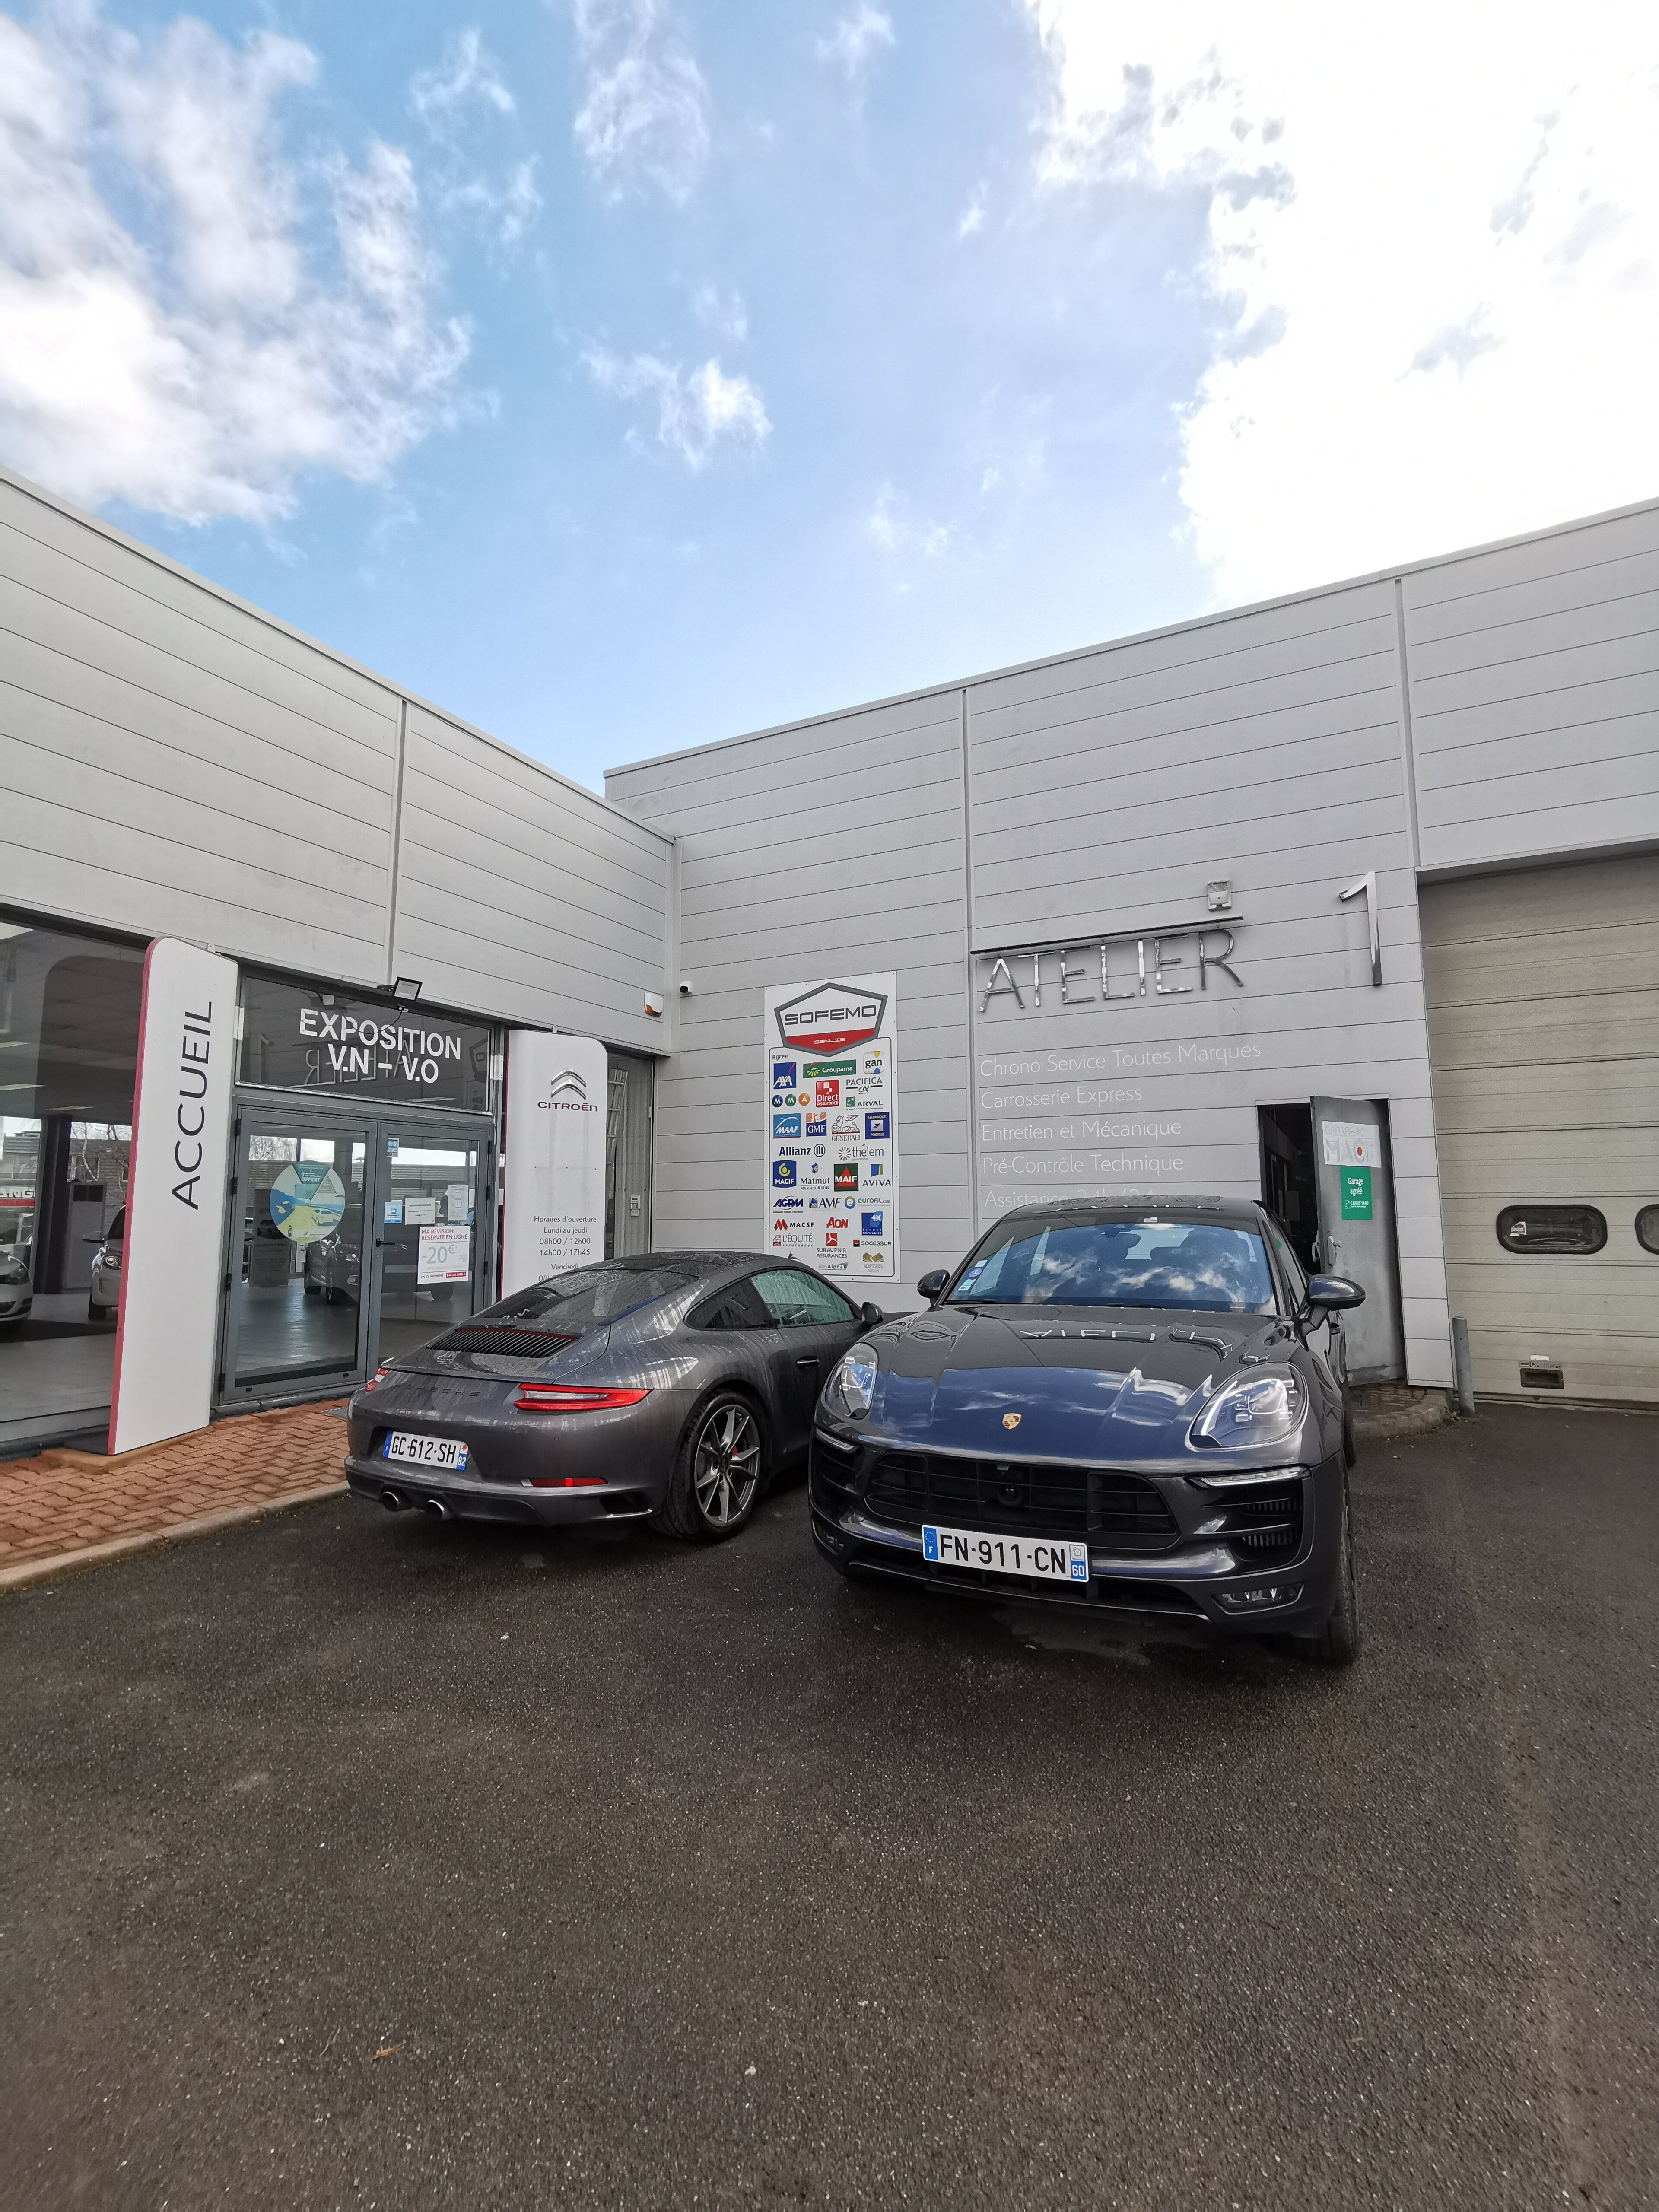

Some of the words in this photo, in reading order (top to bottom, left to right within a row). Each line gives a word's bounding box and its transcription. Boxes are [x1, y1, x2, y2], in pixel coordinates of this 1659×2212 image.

[979, 928, 1244, 1012] ATELIER
[1339, 871, 1383, 987] 1
[785, 1004, 877, 1026] SOFEMO
[299, 1008, 461, 1060] EXPOSITION
[327, 1043, 369, 1074] V.N
[402, 1055, 439, 1083] V.O
[865, 1059, 882, 1069] gan
[980, 1058, 1041, 1077] Chrono
[1047, 1055, 1106, 1072] Service
[1112, 1049, 1171, 1068] Toutes
[1178, 1044, 1262, 1065] Marques
[773, 1075, 793, 1087] AXA
[846, 1077, 883, 1086] PACIFICA
[817, 1093, 839, 1102] Direct
[981, 1089, 1070, 1109] Carrosserie
[1077, 1085, 1143, 1107] Express
[172, 1001, 212, 1210] ACCUEIL
[775, 1126, 799, 1134] MAAF
[807, 1125, 826, 1134] GMF
[983, 1124, 1053, 1141] Entretien
[1059, 1126, 1076, 1139] et
[1083, 1120, 1182, 1141] Mécanique
[779, 1146, 811, 1156] Allianz
[852, 1144, 884, 1157] thélem
[983, 1154, 1084, 1175] Pré-Contrôle
[1090, 1152, 1183, 1176] Technique
[1348, 1177, 1364, 1187] Garage
[773, 1198, 804, 1208] AGPM
[819, 1197, 842, 1208] AMF
[572, 1226, 588, 1235] jeudi
[782, 1233, 813, 1244] L'ÉQUITÉ
[457, 1456, 466, 1466] 92
[939, 1533, 1066, 1574] FN-911-CN
[1072, 1564, 1085, 1577] 60
